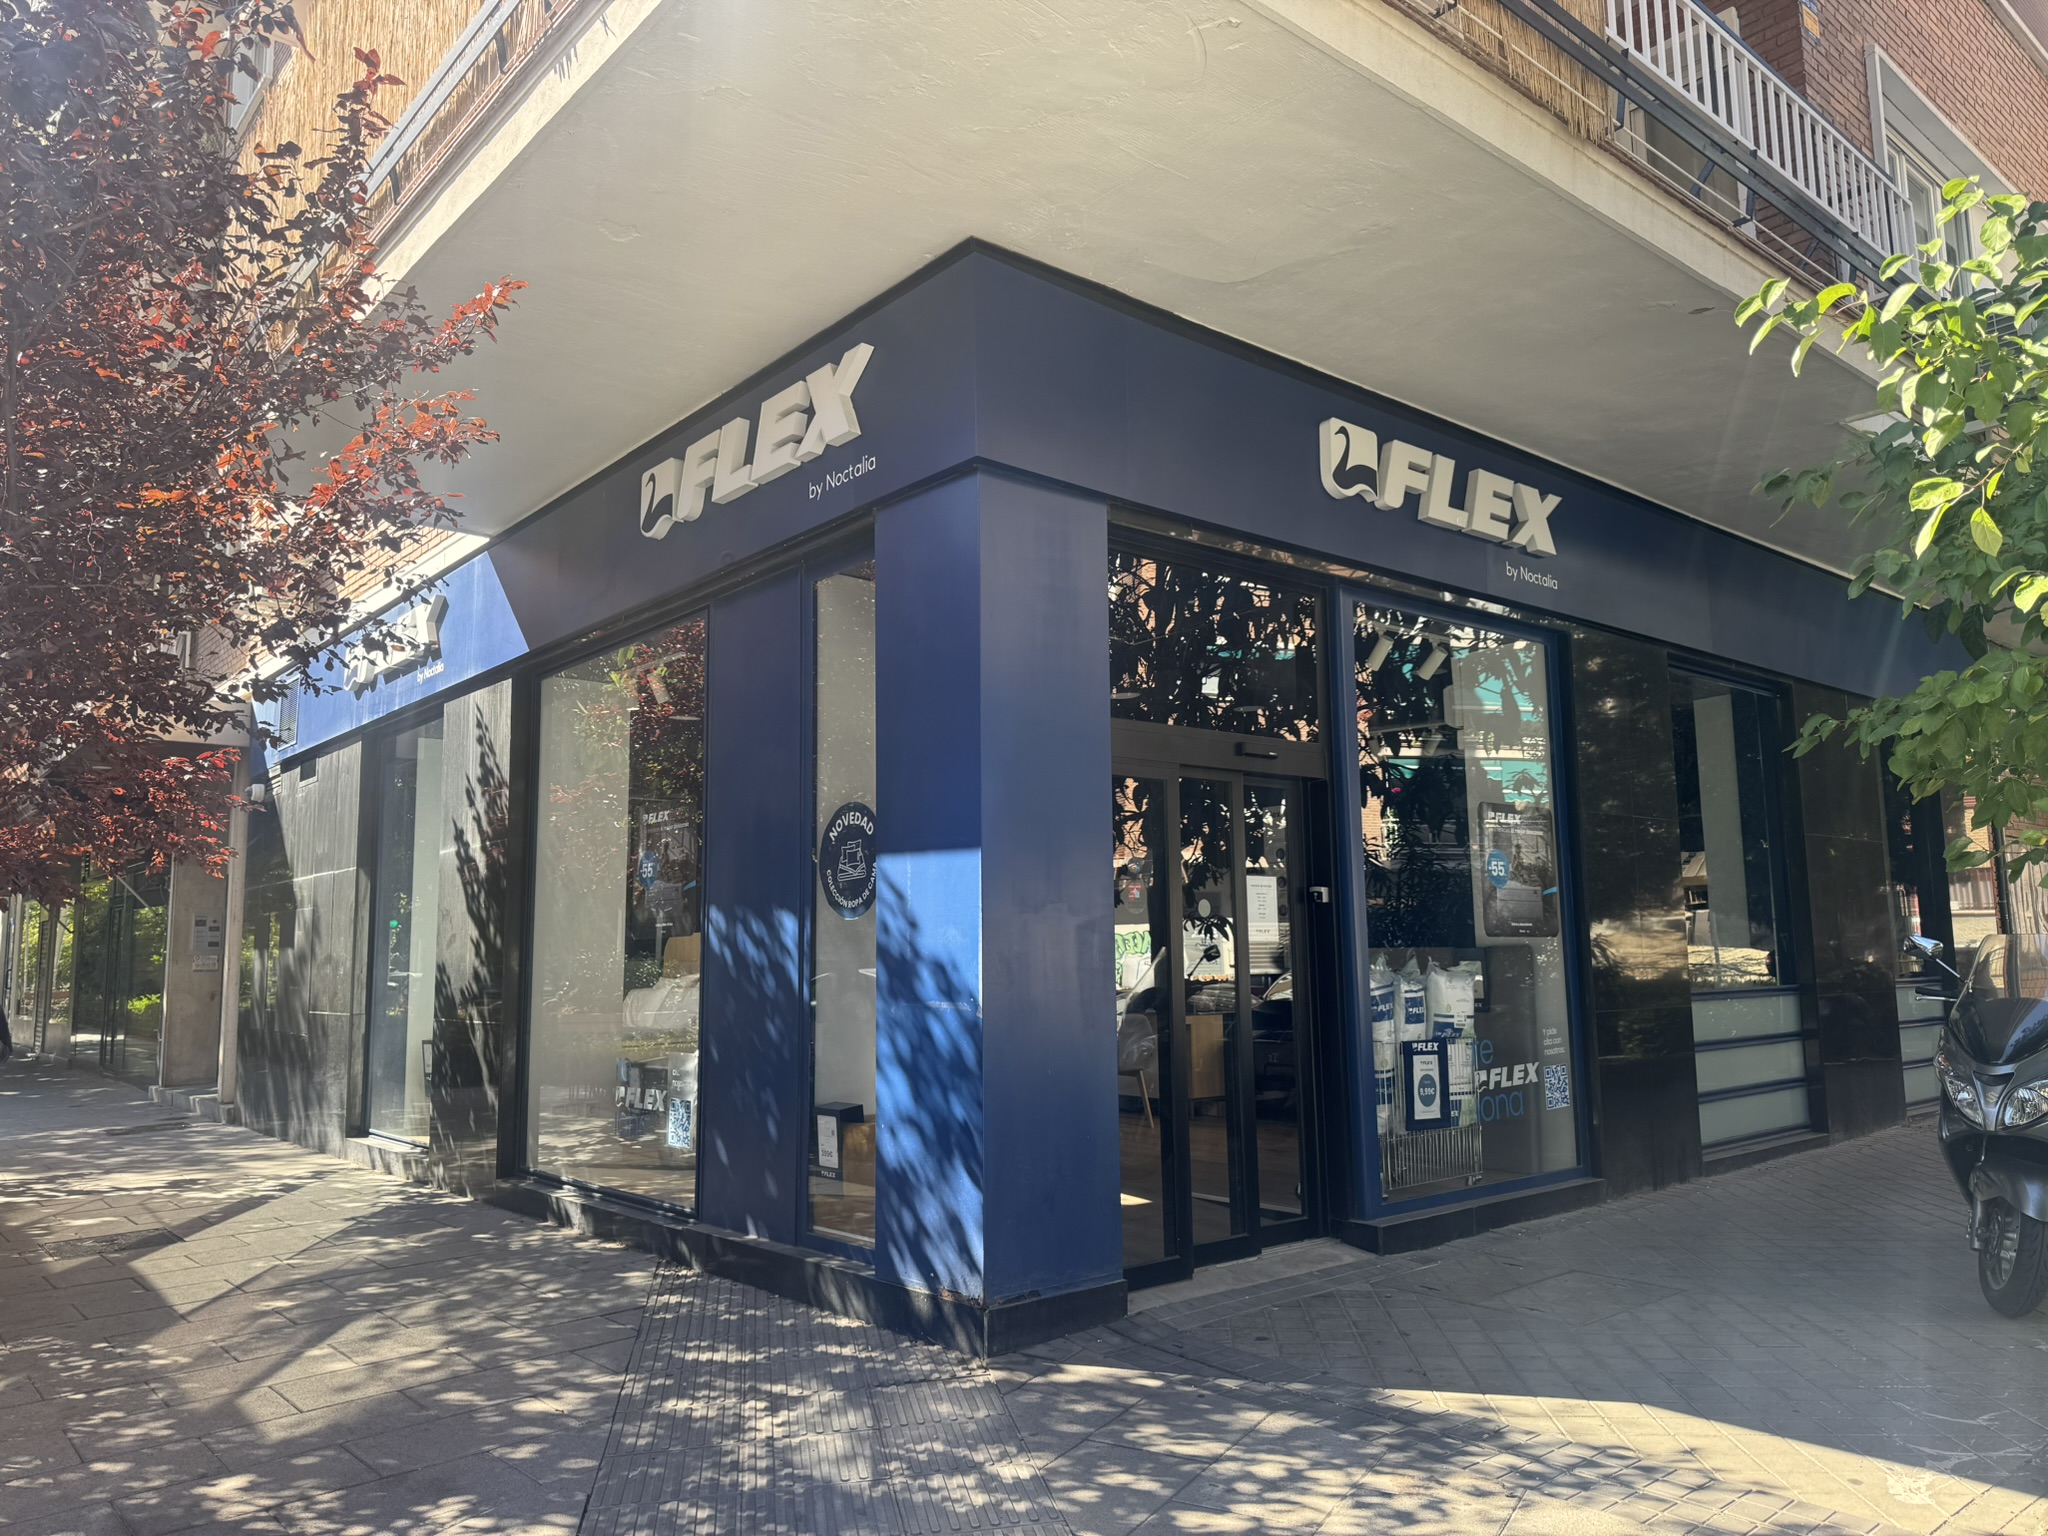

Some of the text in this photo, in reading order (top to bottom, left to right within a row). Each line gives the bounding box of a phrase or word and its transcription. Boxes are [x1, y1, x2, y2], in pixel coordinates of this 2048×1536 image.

[677, 342, 875, 523] FLEX
[808, 455, 877, 501] by Noctalia
[1374, 439, 1563, 556] FLEX
[1505, 561, 1559, 590] by Noctalia
[416, 669, 423, 684] by
[648, 810, 670, 824] FLEX
[828, 811, 875, 842] NOVEDAD
[1494, 812, 1522, 825] FLEX
[1488, 860, 1506, 877] -55
[826, 869, 849, 908] COLECCIÓN
[847, 898, 863, 909] ROPA
[862, 888, 871, 901] DE
[1417, 1042, 1439, 1051] FLEX
[1552, 1037, 1562, 1045] con
[1488, 1062, 1540, 1090] FLEX
[625, 1087, 668, 1112] FLEX
[1481, 1090, 1524, 1122] ona
